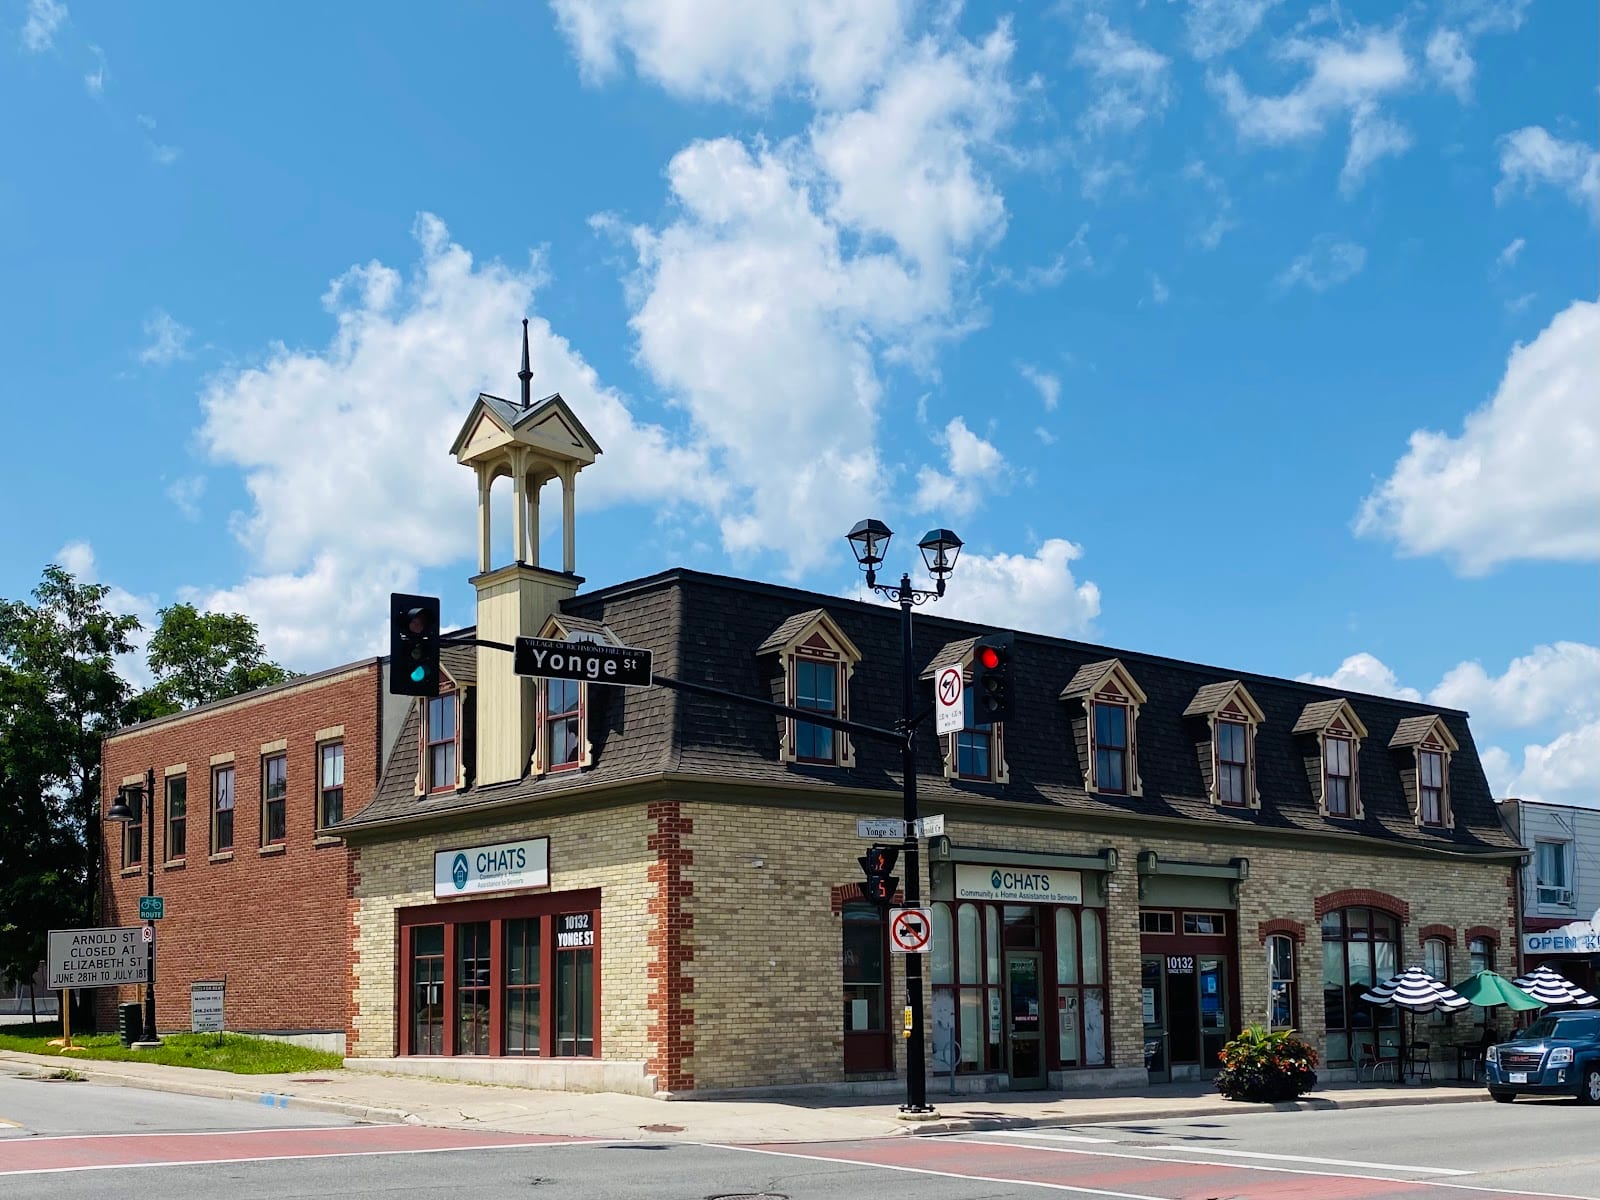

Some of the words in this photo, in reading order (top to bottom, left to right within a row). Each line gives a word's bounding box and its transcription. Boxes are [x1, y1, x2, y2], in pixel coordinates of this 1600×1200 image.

[532, 648, 618, 679] Yonge
[623, 658, 637, 670] St
[866, 827, 887, 838] Yonge
[889, 828, 897, 836] St
[476, 847, 526, 873] CHATS
[1003, 872, 1050, 891] CHATS
[960, 888, 993, 899] Community
[1000, 890, 1017, 899] Home
[1019, 891, 1050, 900] Assistance
[1057, 893, 1078, 902] Seniors
[565, 914, 589, 930] 10132
[72, 934, 117, 945] ARNOLD
[122, 932, 136, 943] ST
[557, 931, 583, 947] YONGE
[584, 930, 594, 945] ST
[1528, 936, 1577, 950] OPEN
[70, 946, 116, 958] CLOSED
[122, 945, 136, 955] AT
[63, 958, 124, 971] ELIZABETH
[129, 957, 143, 967] ST
[1167, 956, 1193, 969] 10132
[53, 973, 74, 984] JUNE
[77, 972, 97, 982] 28TH
[100, 971, 110, 981] TO
[113, 969, 133, 980] JULY
[135, 969, 148, 979] 18T
